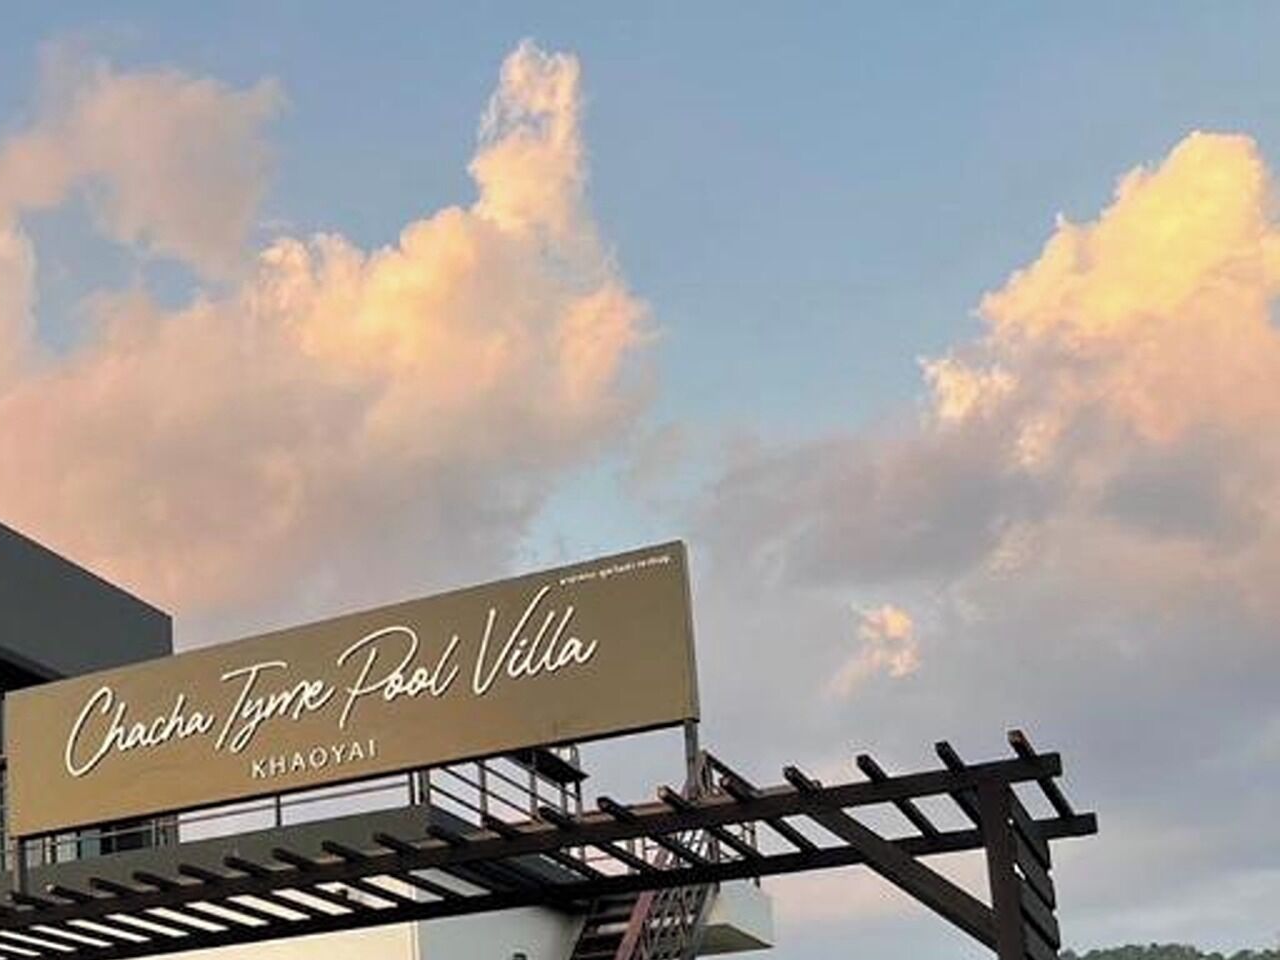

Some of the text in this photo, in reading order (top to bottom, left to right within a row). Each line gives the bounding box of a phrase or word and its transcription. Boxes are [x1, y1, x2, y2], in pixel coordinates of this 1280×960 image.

[65, 686, 214, 776] Chacha
[337, 625, 459, 729] Pool
[473, 585, 598, 695] Villa
[251, 739, 376, 778] KHAOYAI
